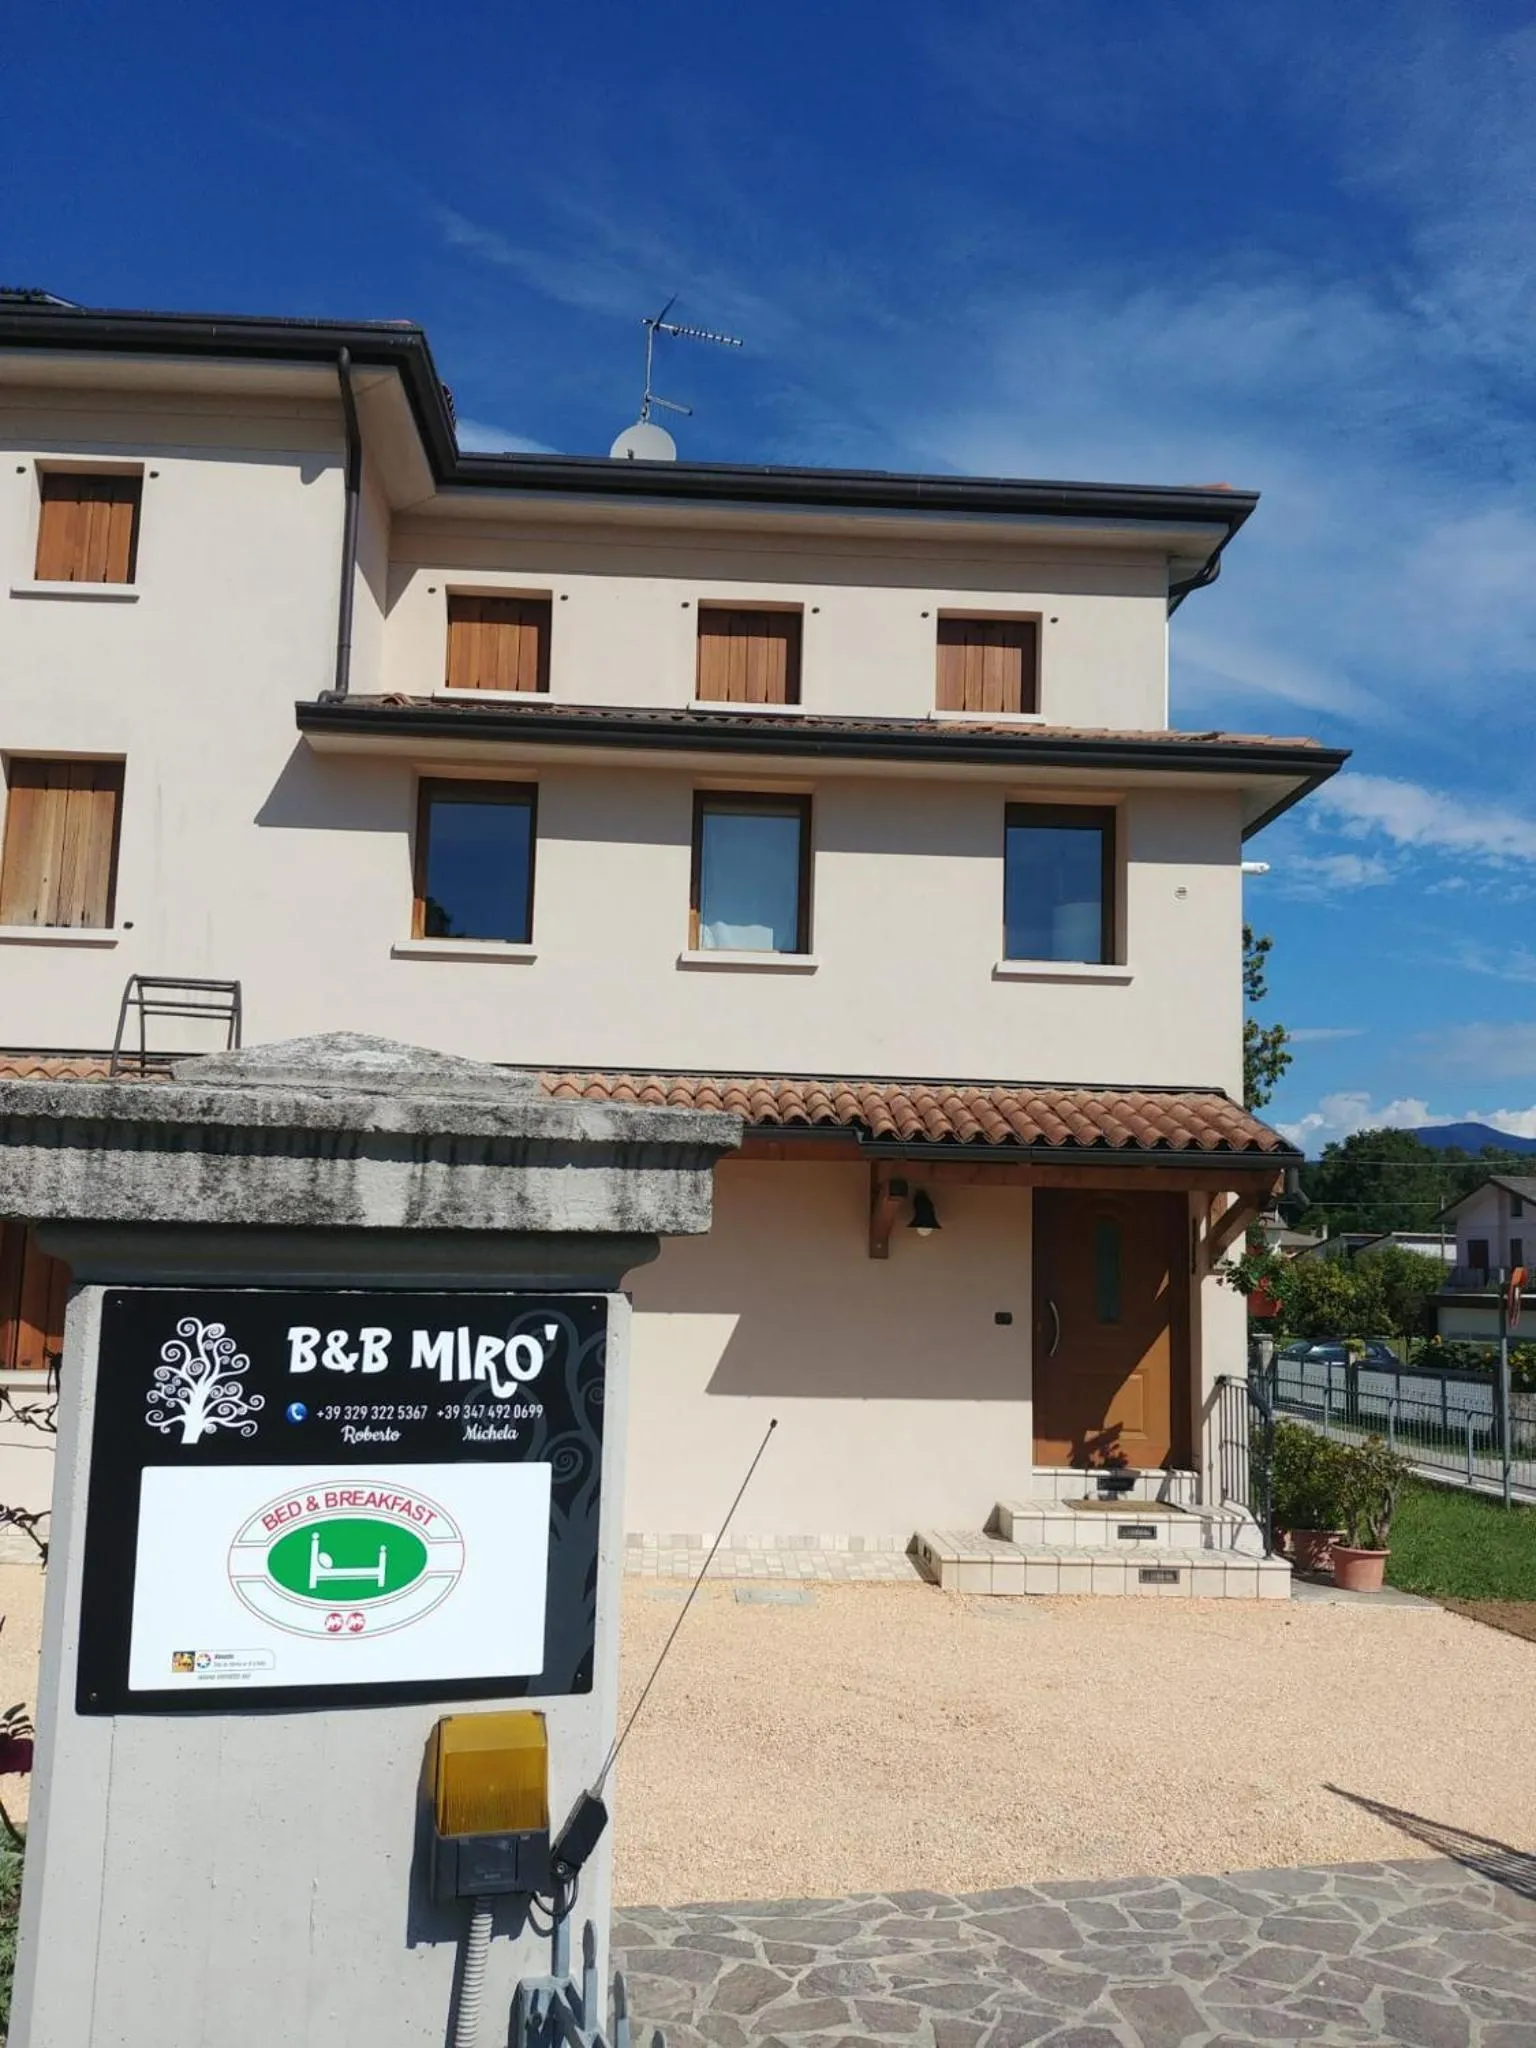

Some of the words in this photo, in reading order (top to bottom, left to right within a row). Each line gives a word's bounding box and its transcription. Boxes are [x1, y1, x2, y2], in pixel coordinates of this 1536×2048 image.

[287, 1326, 392, 1374] B&B
[316, 1405, 341, 1420] +39
[344, 1405, 367, 1420] 329
[371, 1405, 394, 1420] 322
[397, 1404, 428, 1420] 5367
[437, 1404, 460, 1419] +39
[463, 1404, 486, 1419] 347
[488, 1404, 511, 1419] 492
[513, 1403, 544, 1419] 0699
[341, 1425, 401, 1444] Roberto
[462, 1423, 519, 1442] Michela
[261, 1501, 303, 1532] BED
[306, 1495, 320, 1512] &
[324, 1490, 438, 1527] BREAKFAST
